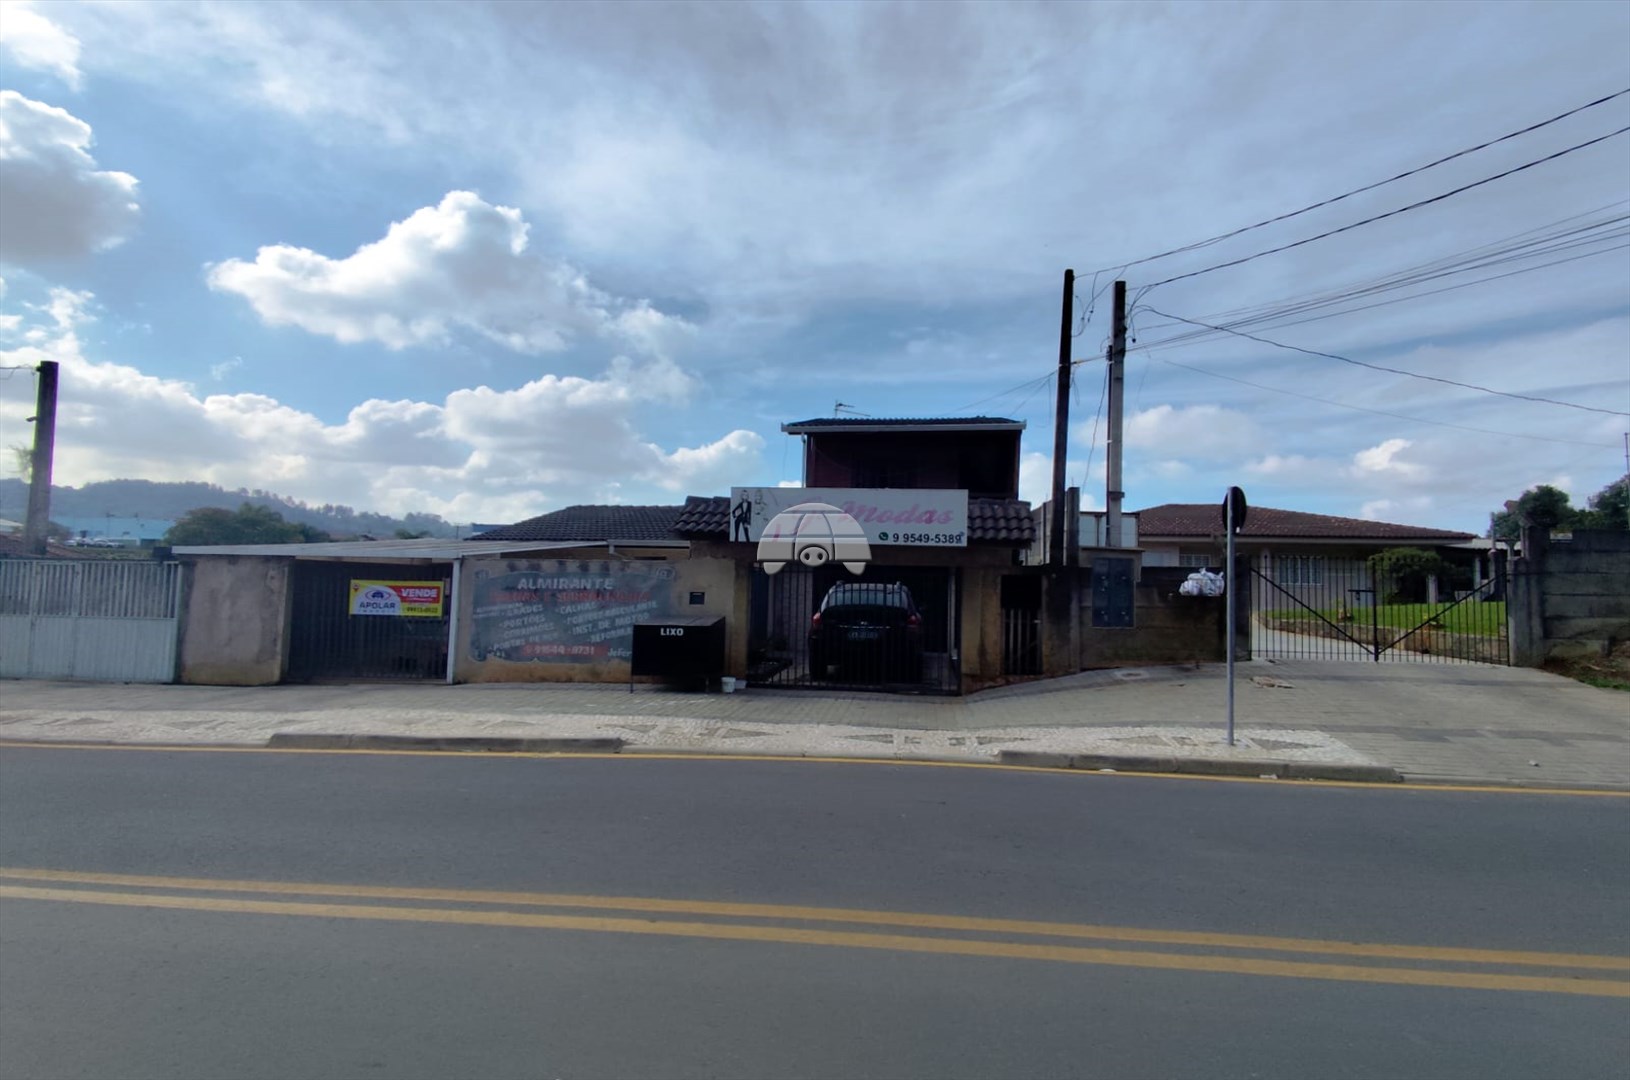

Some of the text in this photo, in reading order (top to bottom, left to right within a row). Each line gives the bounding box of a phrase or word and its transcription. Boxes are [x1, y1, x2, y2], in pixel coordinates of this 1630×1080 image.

[893, 532, 900, 543] 9
[518, 578, 614, 589] ALMIRANTE
[401, 588, 438, 598] VENDE
[660, 628, 684, 636] LIXO
